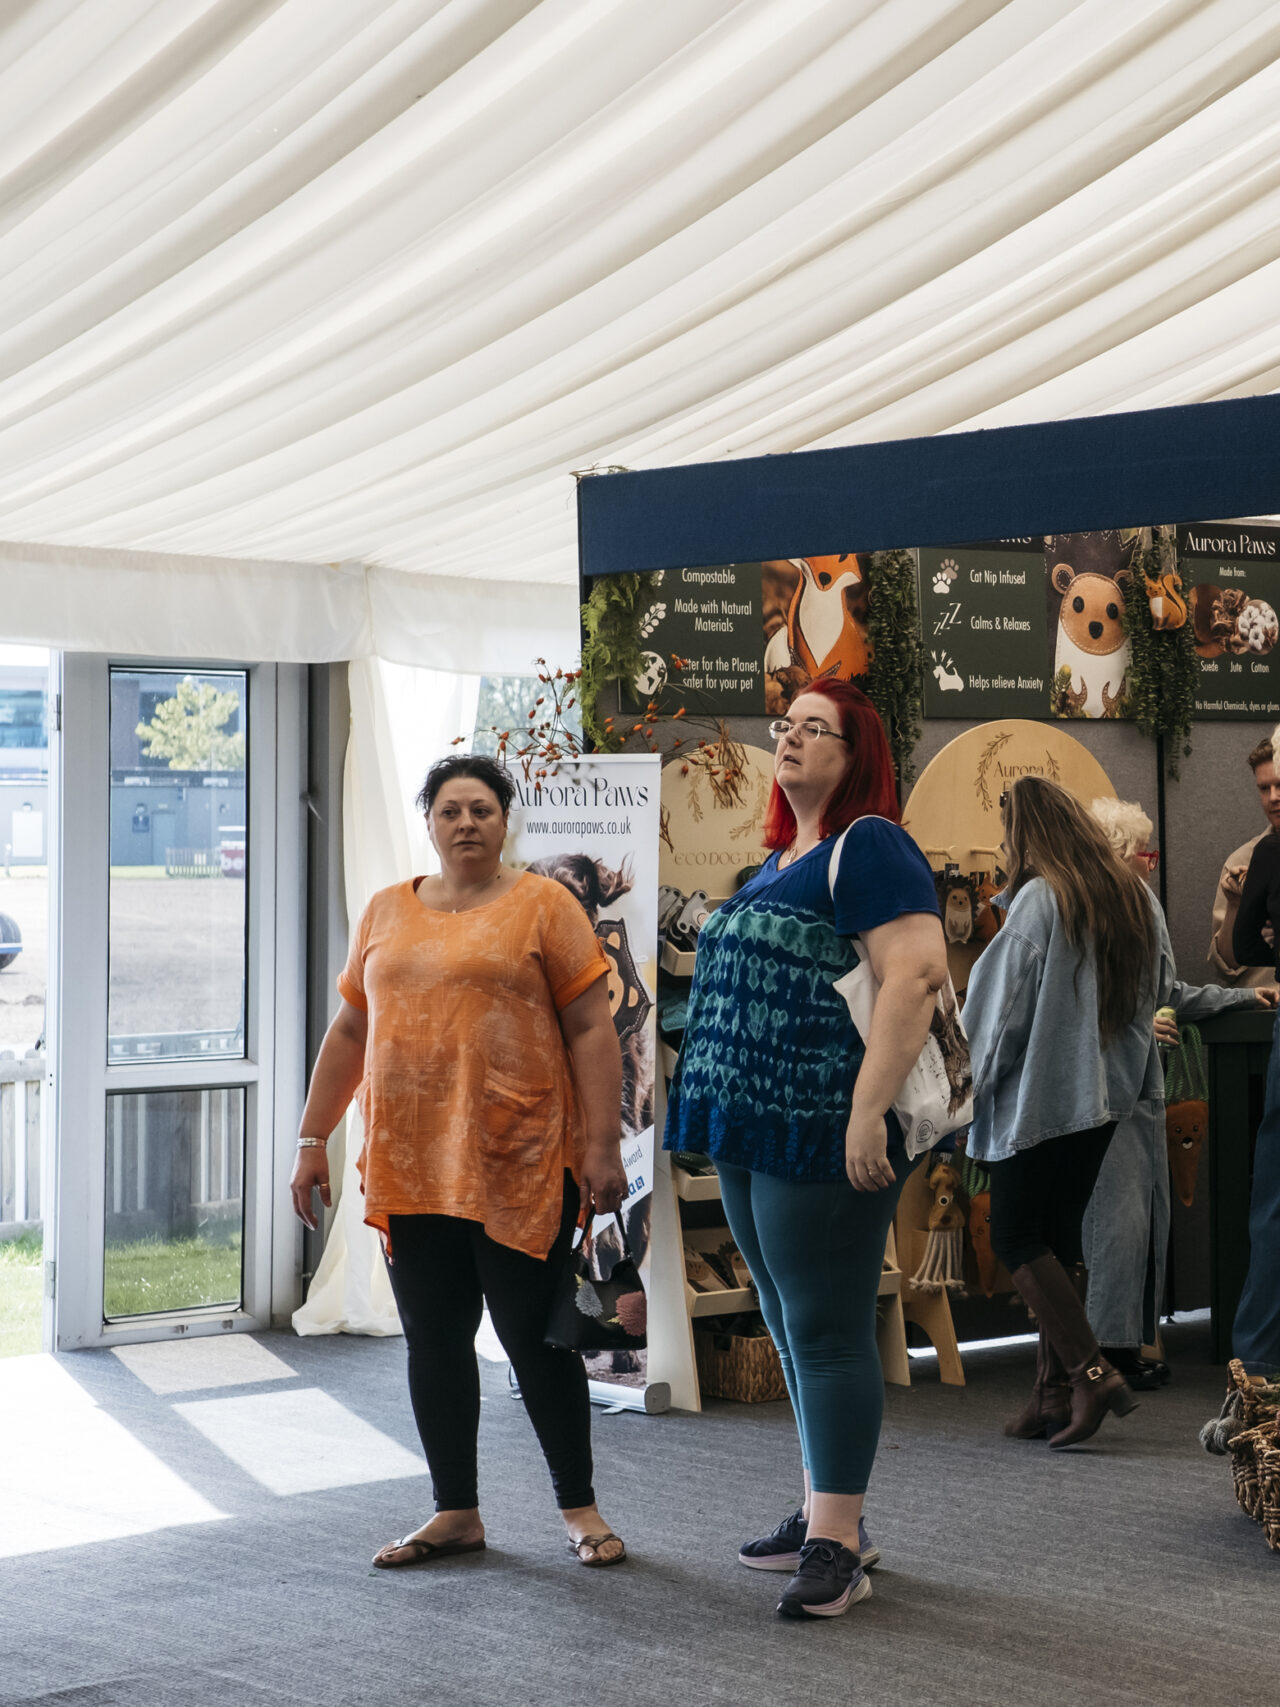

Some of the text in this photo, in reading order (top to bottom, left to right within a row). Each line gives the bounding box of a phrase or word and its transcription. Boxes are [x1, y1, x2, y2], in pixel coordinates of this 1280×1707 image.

[1185, 532, 1276, 555] Aurora Paws
[682, 568, 736, 586] Compostable
[970, 569, 1026, 586] Cat Nip Infused
[675, 599, 752, 616] Made with Natural
[694, 617, 734, 632] Materials
[970, 616, 1031, 631] Calms & Relaxes
[702, 656, 714, 671] for
[716, 657, 730, 671] the
[731, 657, 761, 675] Planet,
[1200, 660, 1270, 673] Suede Jute Cotton
[682, 674, 753, 692] safer for your pet
[968, 675, 1044, 692] Helps relieve Anxiety
[993, 760, 1044, 777] Aurora
[514, 777, 649, 807] Aurora Paws
[526, 816, 632, 838] www.aurorapaws.co.uk
[622, 1144, 643, 1169] Award
